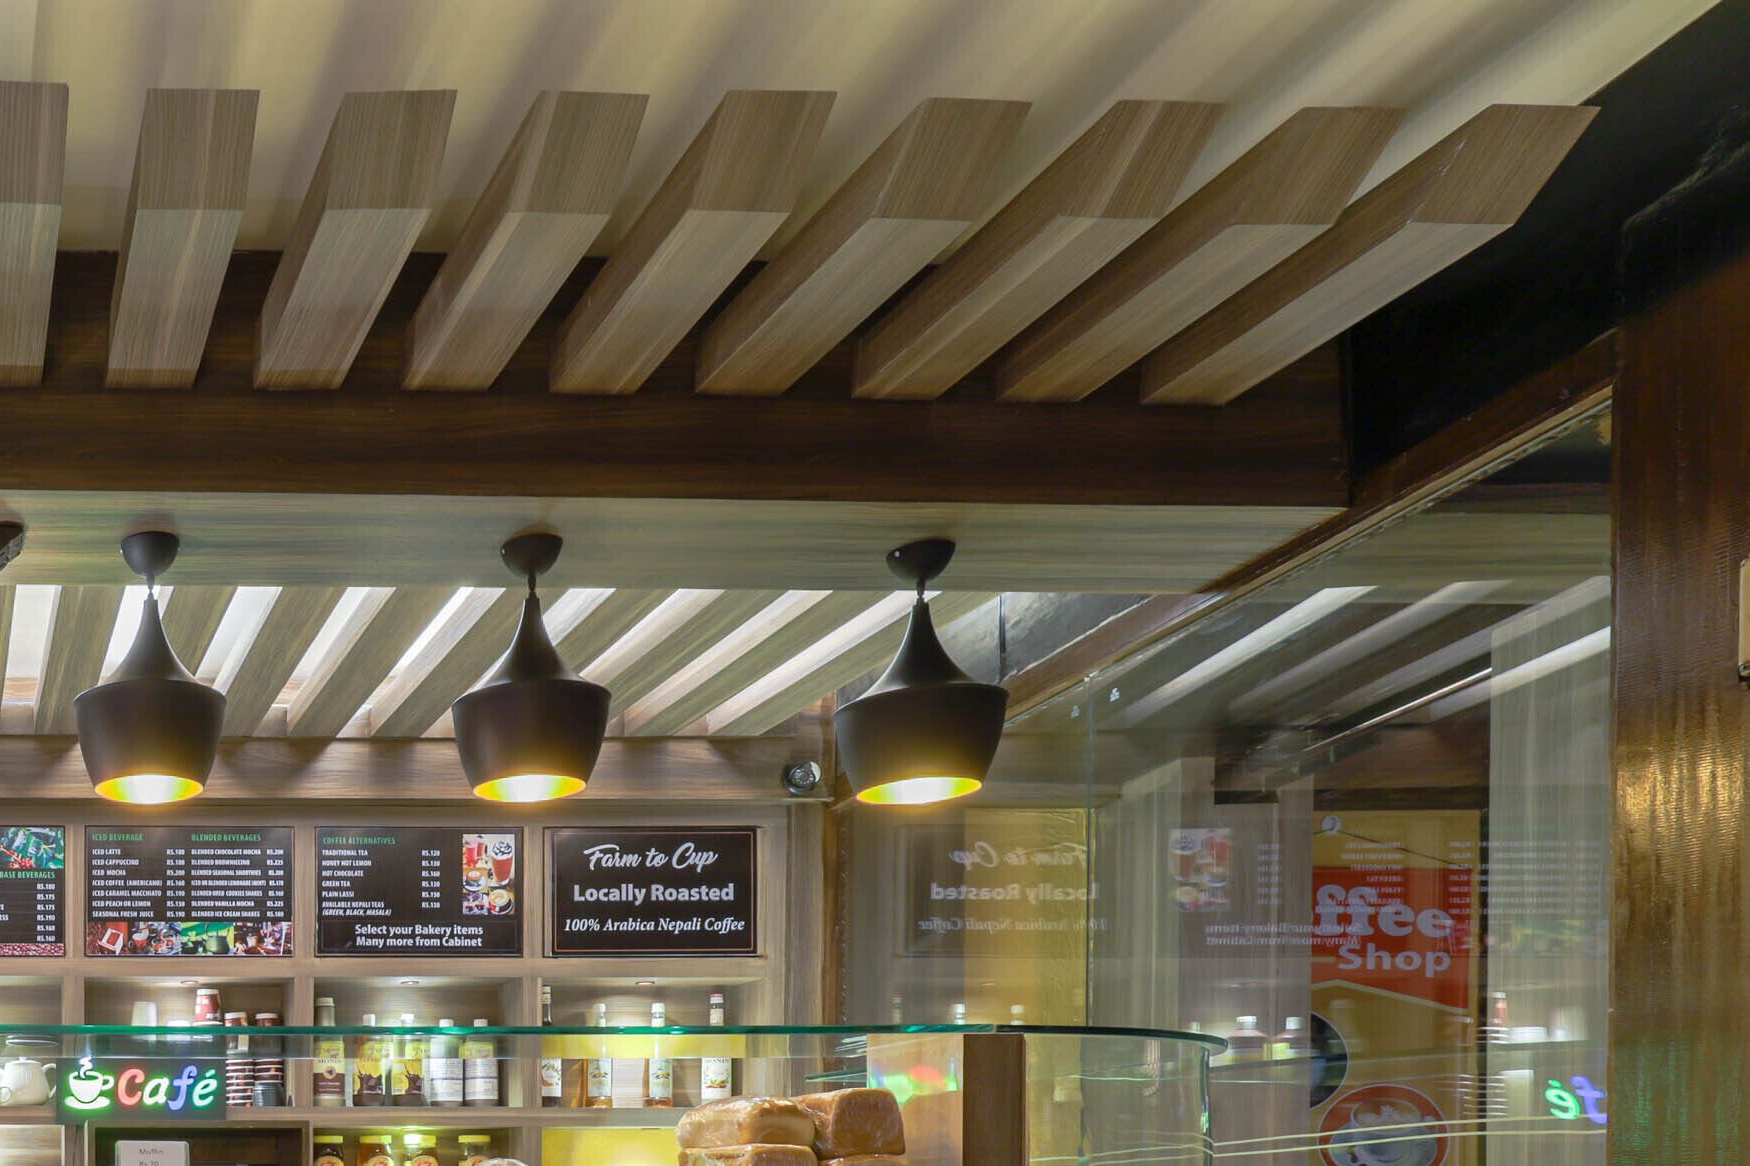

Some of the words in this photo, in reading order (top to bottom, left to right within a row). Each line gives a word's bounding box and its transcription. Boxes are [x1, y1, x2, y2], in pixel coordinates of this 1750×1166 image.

[584, 843, 641, 870] Farm
[646, 847, 668, 867] to
[672, 842, 718, 872] Cup
[574, 884, 646, 905] Locally
[651, 883, 734, 901] Roasted
[1316, 884, 1454, 937] ffee
[355, 925, 387, 934] Select
[389, 927, 412, 937] your
[415, 925, 451, 937] Bakery
[453, 925, 483, 934] items
[564, 918, 599, 931] 100%
[603, 918, 654, 931] Arabica
[658, 918, 700, 934] Nepali
[704, 917, 745, 934] Coffee
[357, 937, 384, 948] Many
[416, 937, 440, 946] from
[442, 937, 482, 947] Cabinet
[1337, 943, 1451, 977] Shop
[117, 1065, 218, 1111] Café
